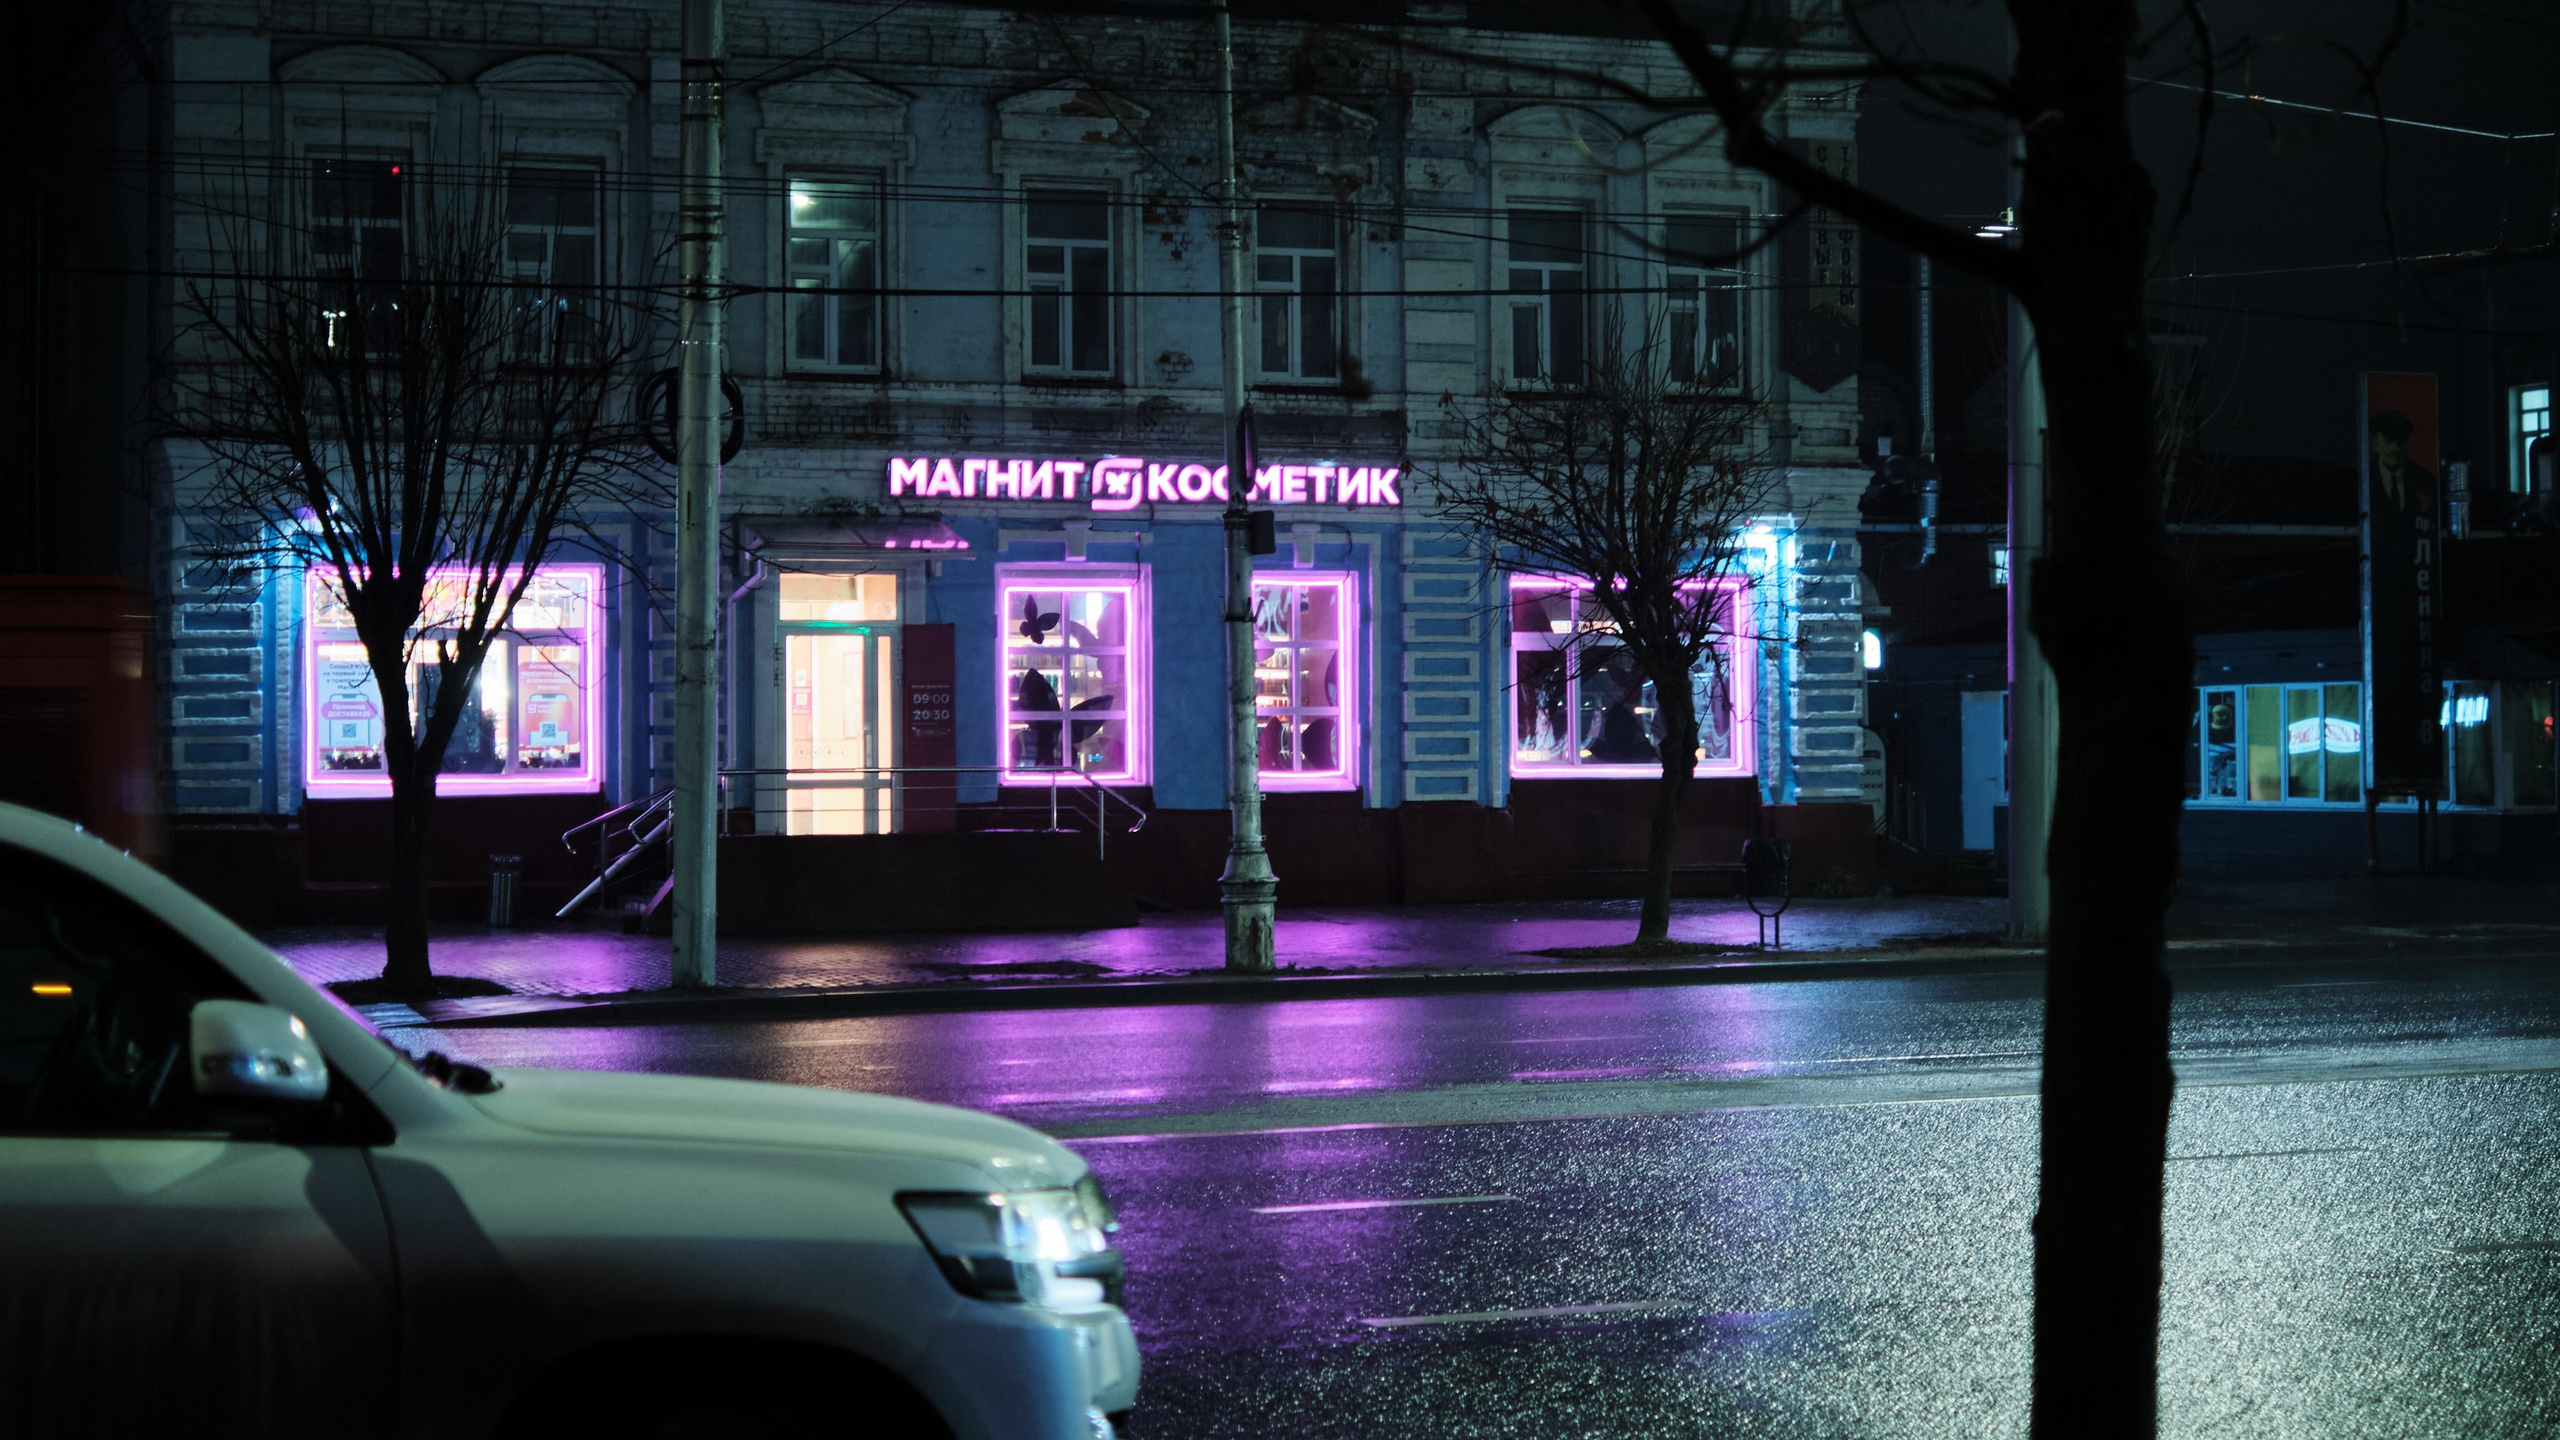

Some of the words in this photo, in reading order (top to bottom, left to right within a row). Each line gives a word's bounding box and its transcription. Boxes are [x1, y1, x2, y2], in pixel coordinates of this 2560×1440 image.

[1838, 146, 1854, 306] ТЕФОНЫ
[888, 458, 1085, 500] МАГНИТ
[1148, 463, 1402, 506] КОСМЕТИК
[2415, 515, 2436, 532] Пр.
[2413, 538, 2433, 694] Ленина
[913, 693, 950, 704] 09:00
[913, 709, 950, 720] 20:30
[2419, 718, 2434, 746] 8
